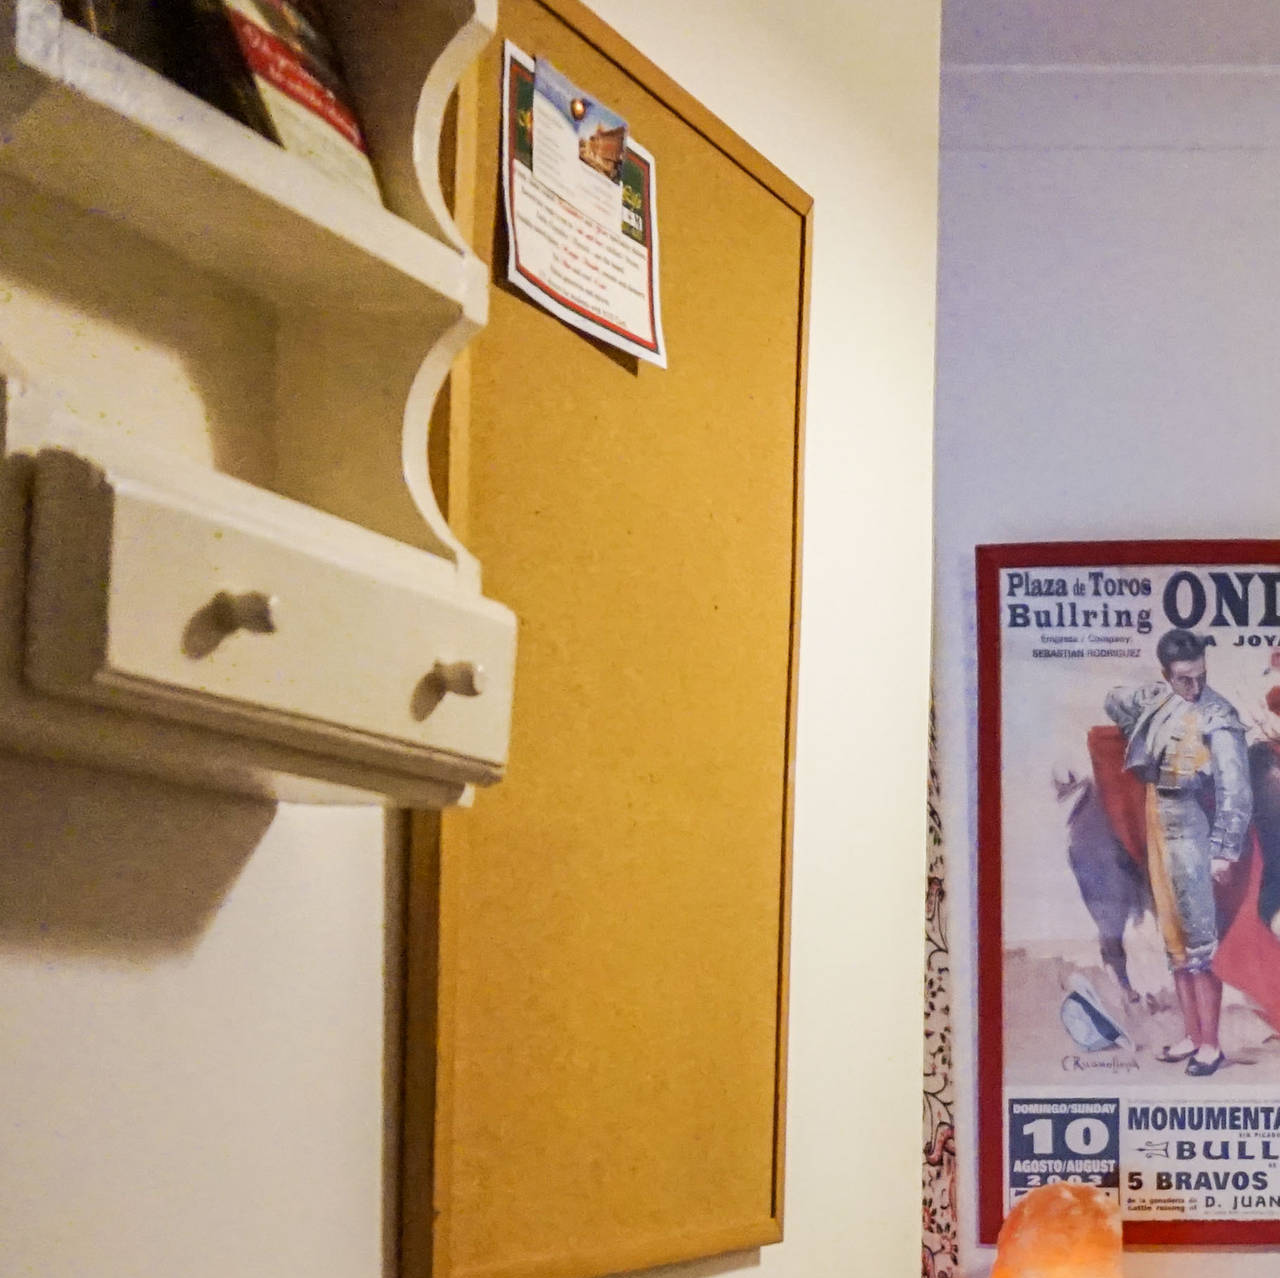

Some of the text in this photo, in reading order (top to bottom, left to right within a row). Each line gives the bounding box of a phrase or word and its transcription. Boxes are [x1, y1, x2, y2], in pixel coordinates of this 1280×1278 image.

[1006, 571, 1153, 597] Plaza de Toros
[1007, 602, 1153, 634] Bullring
[1013, 1104, 1116, 1115] DOMINGO/SUNDAY
[1022, 1118, 1110, 1155] 10
[1014, 1159, 1115, 1174] AGOSTO/AUGUST
[1128, 1172, 1143, 1190] 5
[1156, 1171, 1268, 1190] BRAVOS
[1205, 1196, 1223, 1208] D.
[1233, 1196, 1280, 1209] JUAN
